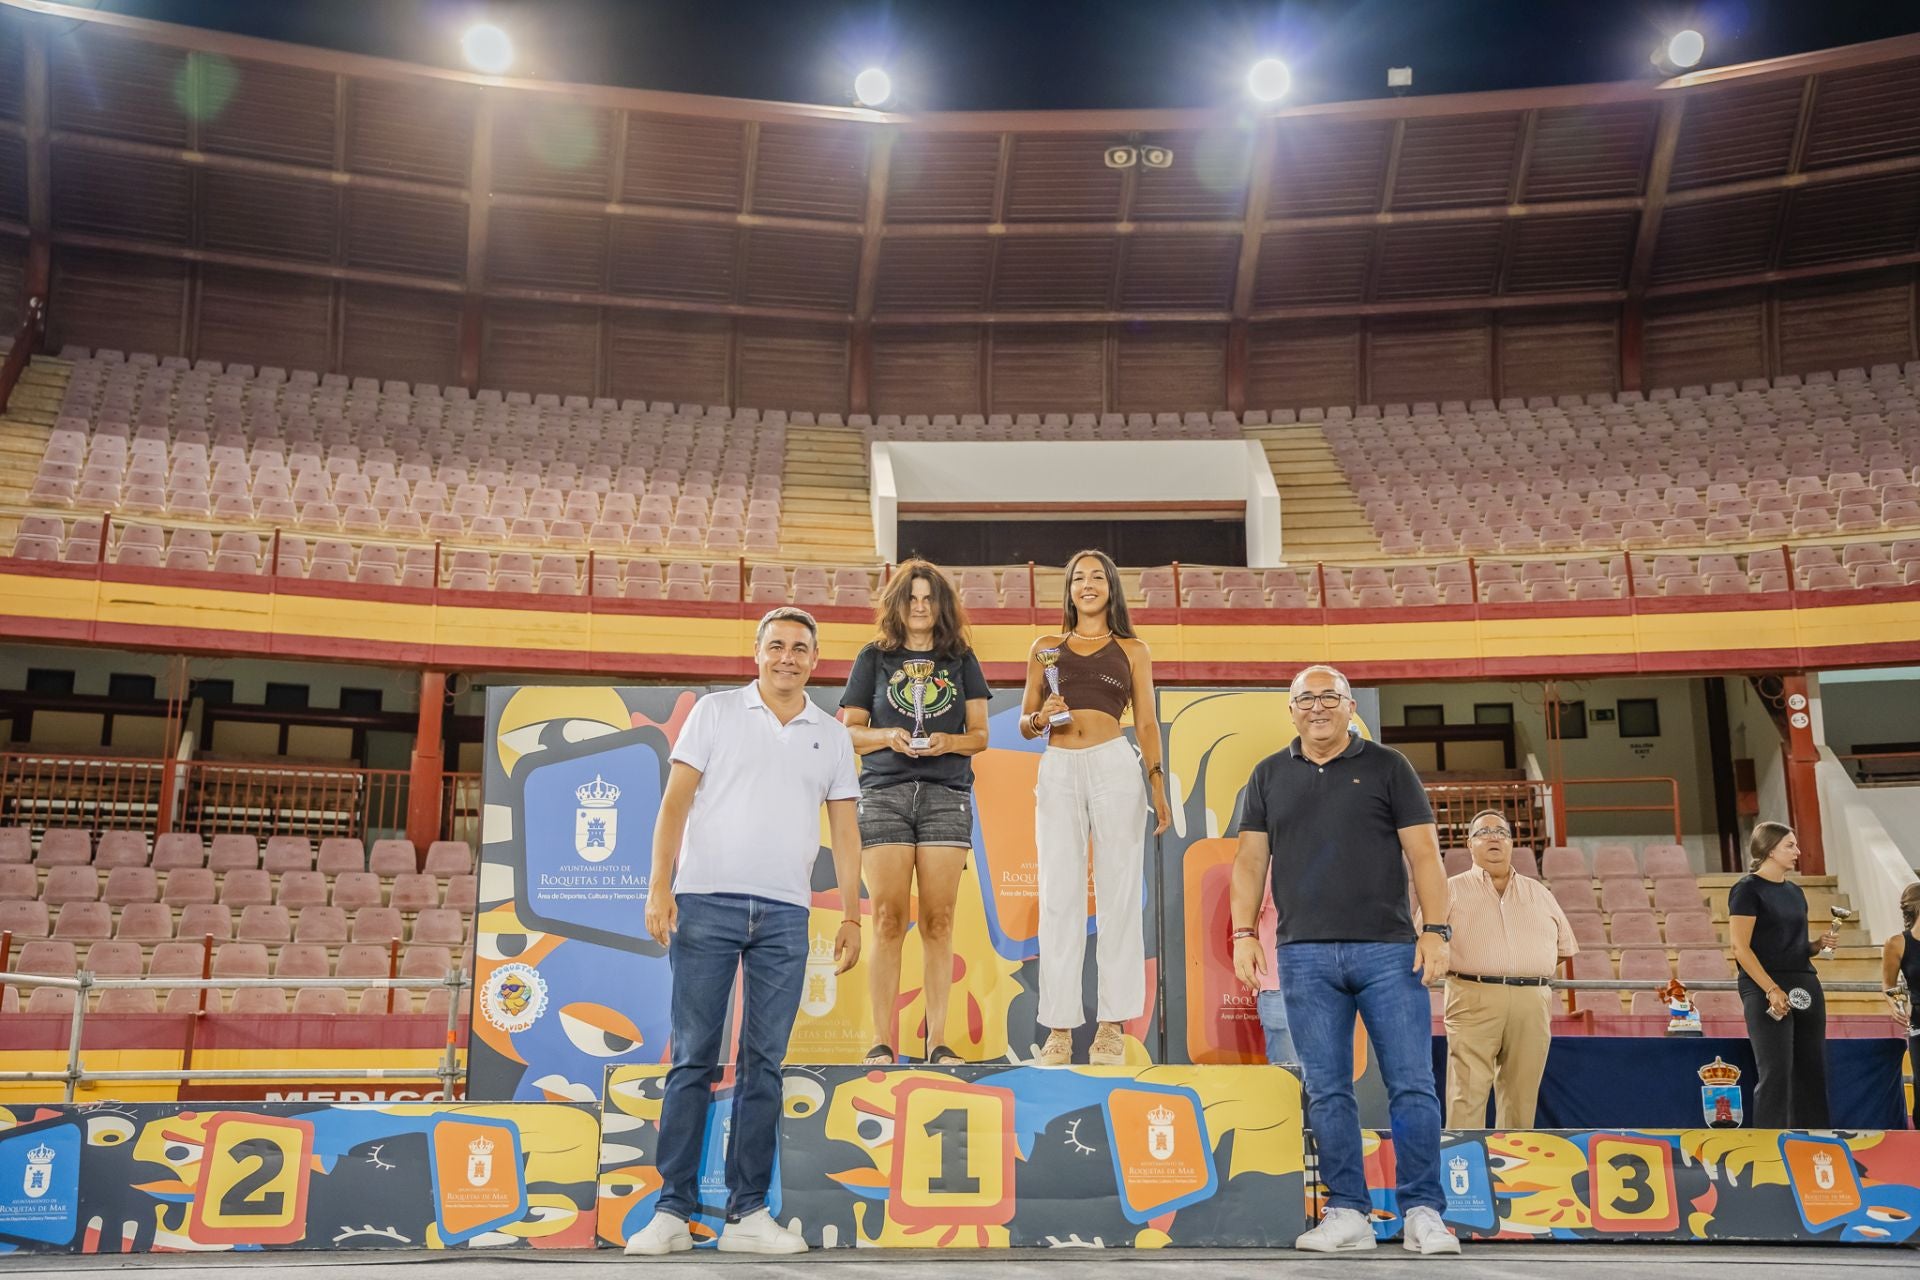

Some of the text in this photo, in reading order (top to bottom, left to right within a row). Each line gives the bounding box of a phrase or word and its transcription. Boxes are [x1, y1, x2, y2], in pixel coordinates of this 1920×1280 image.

[1002, 871, 1039, 884] ROQU
[1223, 993, 1257, 1007] ROQU
[265, 1091, 465, 1102] MEDICO
[923, 1108, 980, 1193] 1
[219, 1138, 284, 1215] 2
[1608, 1153, 1655, 1214] 3
